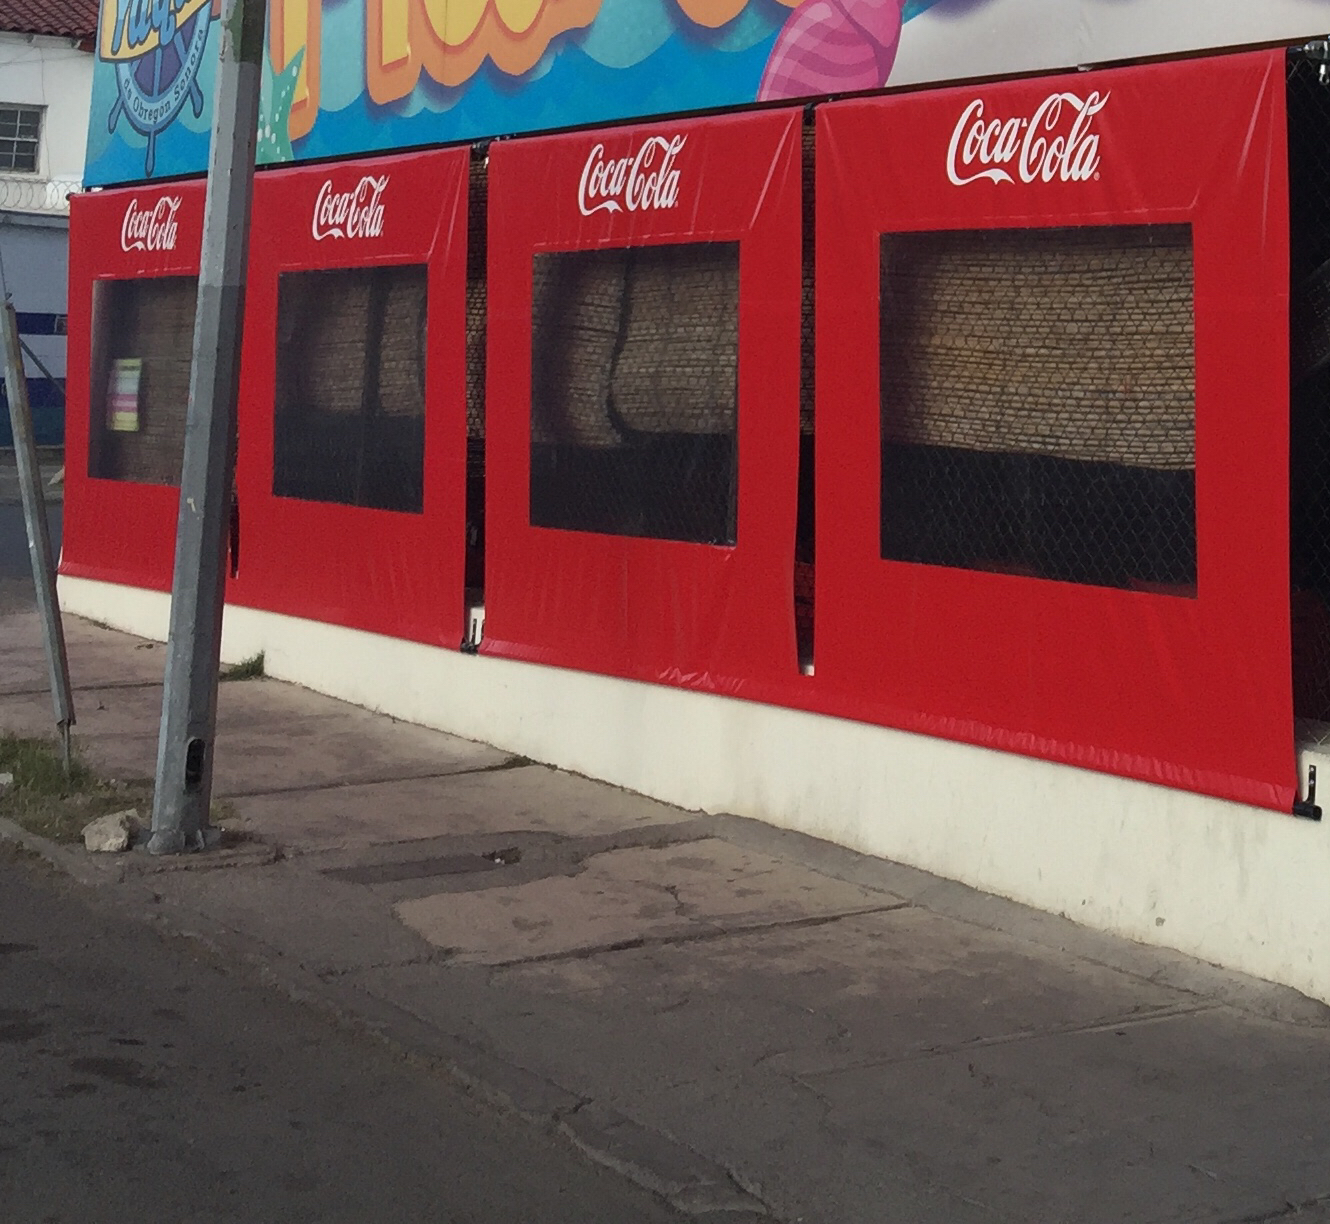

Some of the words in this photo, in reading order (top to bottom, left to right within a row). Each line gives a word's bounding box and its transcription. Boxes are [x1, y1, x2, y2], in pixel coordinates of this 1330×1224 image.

[577, 133, 688, 216] Coca-Cola
[946, 89, 1111, 186] Coca-Cola
[121, 195, 183, 252] Coca-Cola
[312, 173, 390, 241] Coca-Cola
